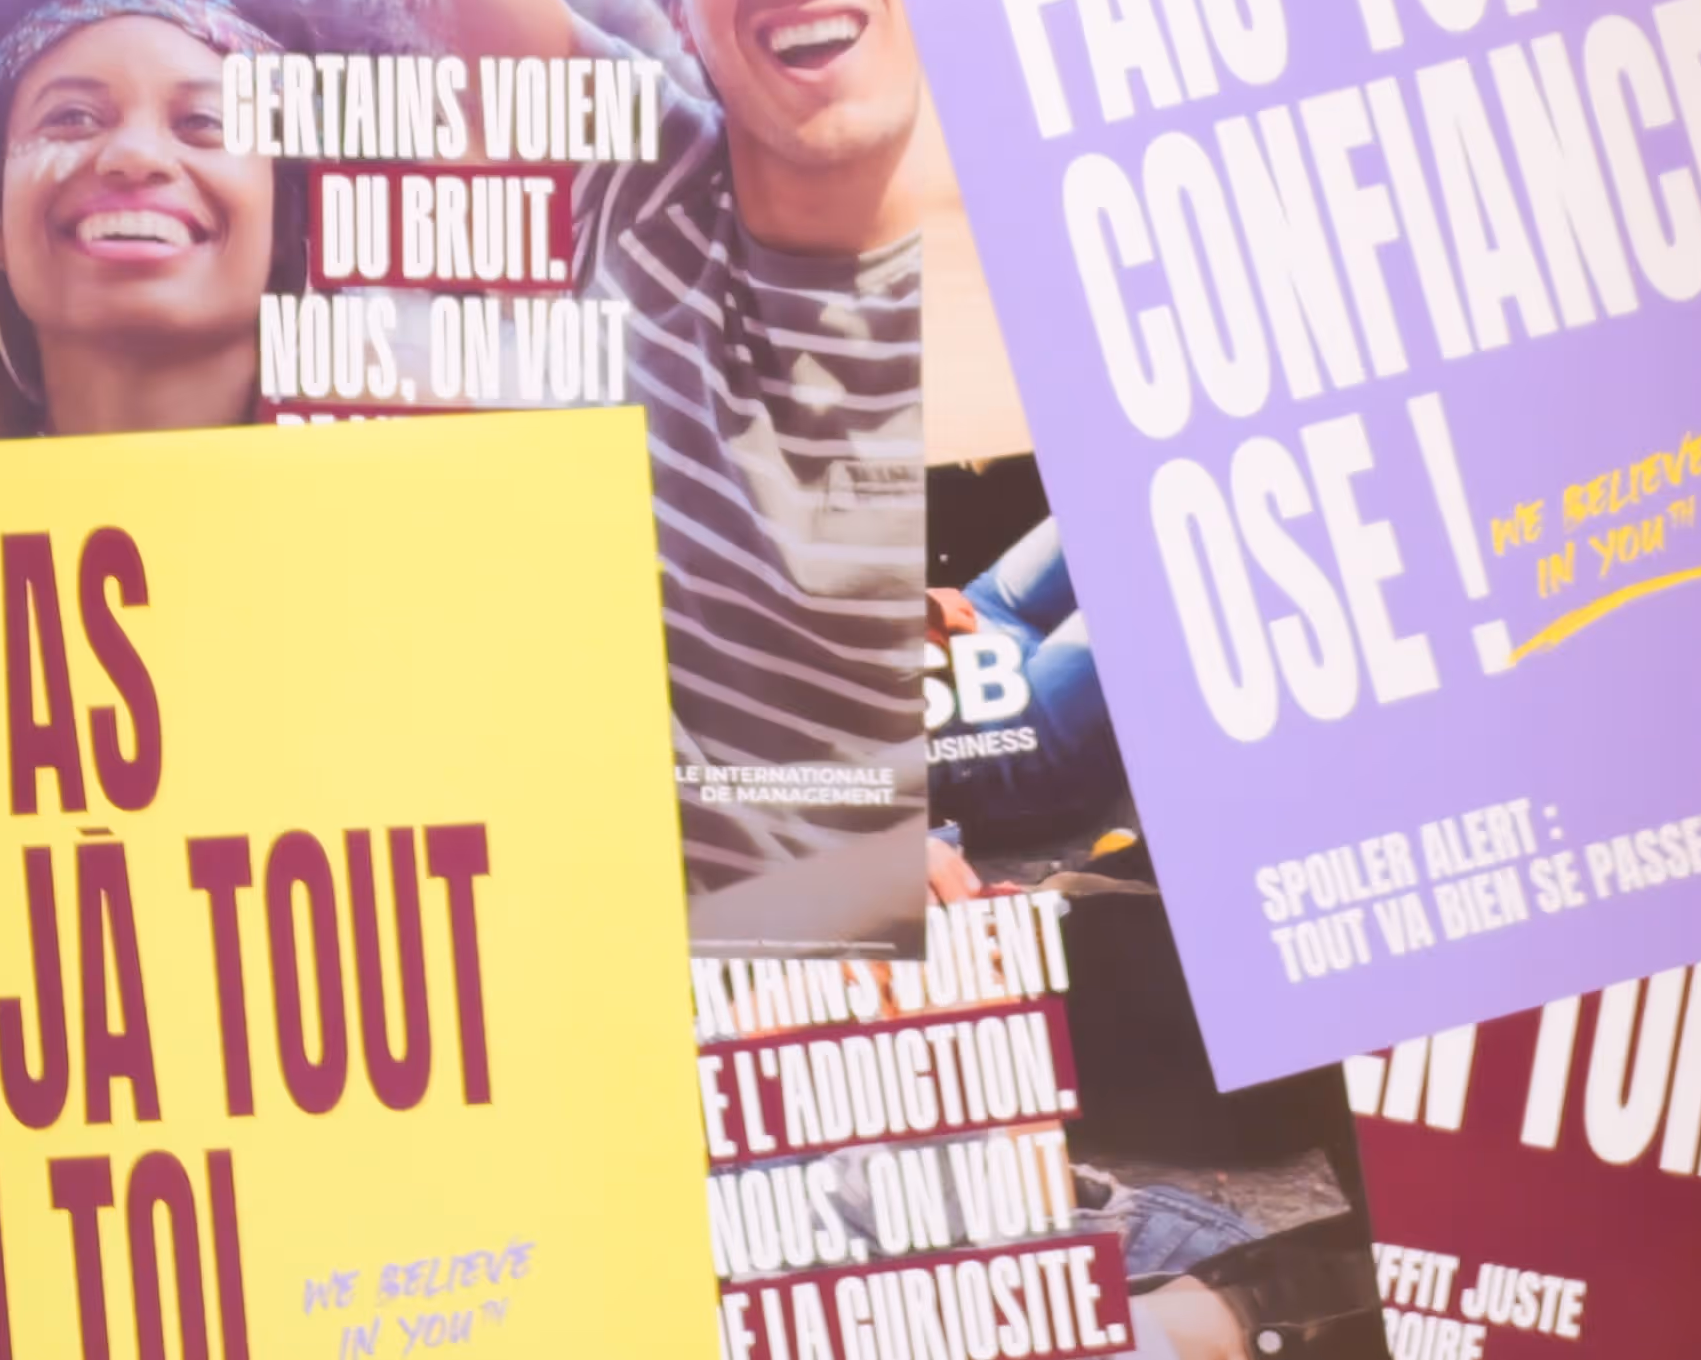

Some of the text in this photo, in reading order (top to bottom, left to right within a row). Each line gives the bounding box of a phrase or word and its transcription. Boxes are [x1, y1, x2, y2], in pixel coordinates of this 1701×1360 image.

[221, 53, 663, 163] CERTAINS VOIENT
[322, 174, 567, 281] DU BRUIT.
[429, 295, 500, 401] ON
[513, 297, 631, 402] VOIT
[1148, 413, 1441, 744] OSE
[1491, 498, 1544, 556] WE
[1537, 541, 1575, 599] IN
[0, 525, 163, 816] AS
[702, 787, 894, 805] DE MANAGEMENT
[703, 767, 893, 785] INTERNATIONALE
[926, 727, 1037, 762] USINESS
[1255, 831, 1419, 922] SPOILER
[1420, 797, 1537, 879] ALERT
[187, 822, 492, 1118] TOUT
[1271, 908, 1371, 982] TOUT
[1373, 892, 1436, 955] VA
[1433, 866, 1530, 941] BIEN
[1530, 851, 1587, 914] SE
[867, 1147, 950, 1255] ON
[949, 1130, 1073, 1244] VOIT
[48, 1148, 252, 1360] TOI
[304, 1234, 536, 1316] WE BELIEVE
[1461, 1263, 1587, 1339] JUSTE
[340, 1315, 381, 1360] IN
